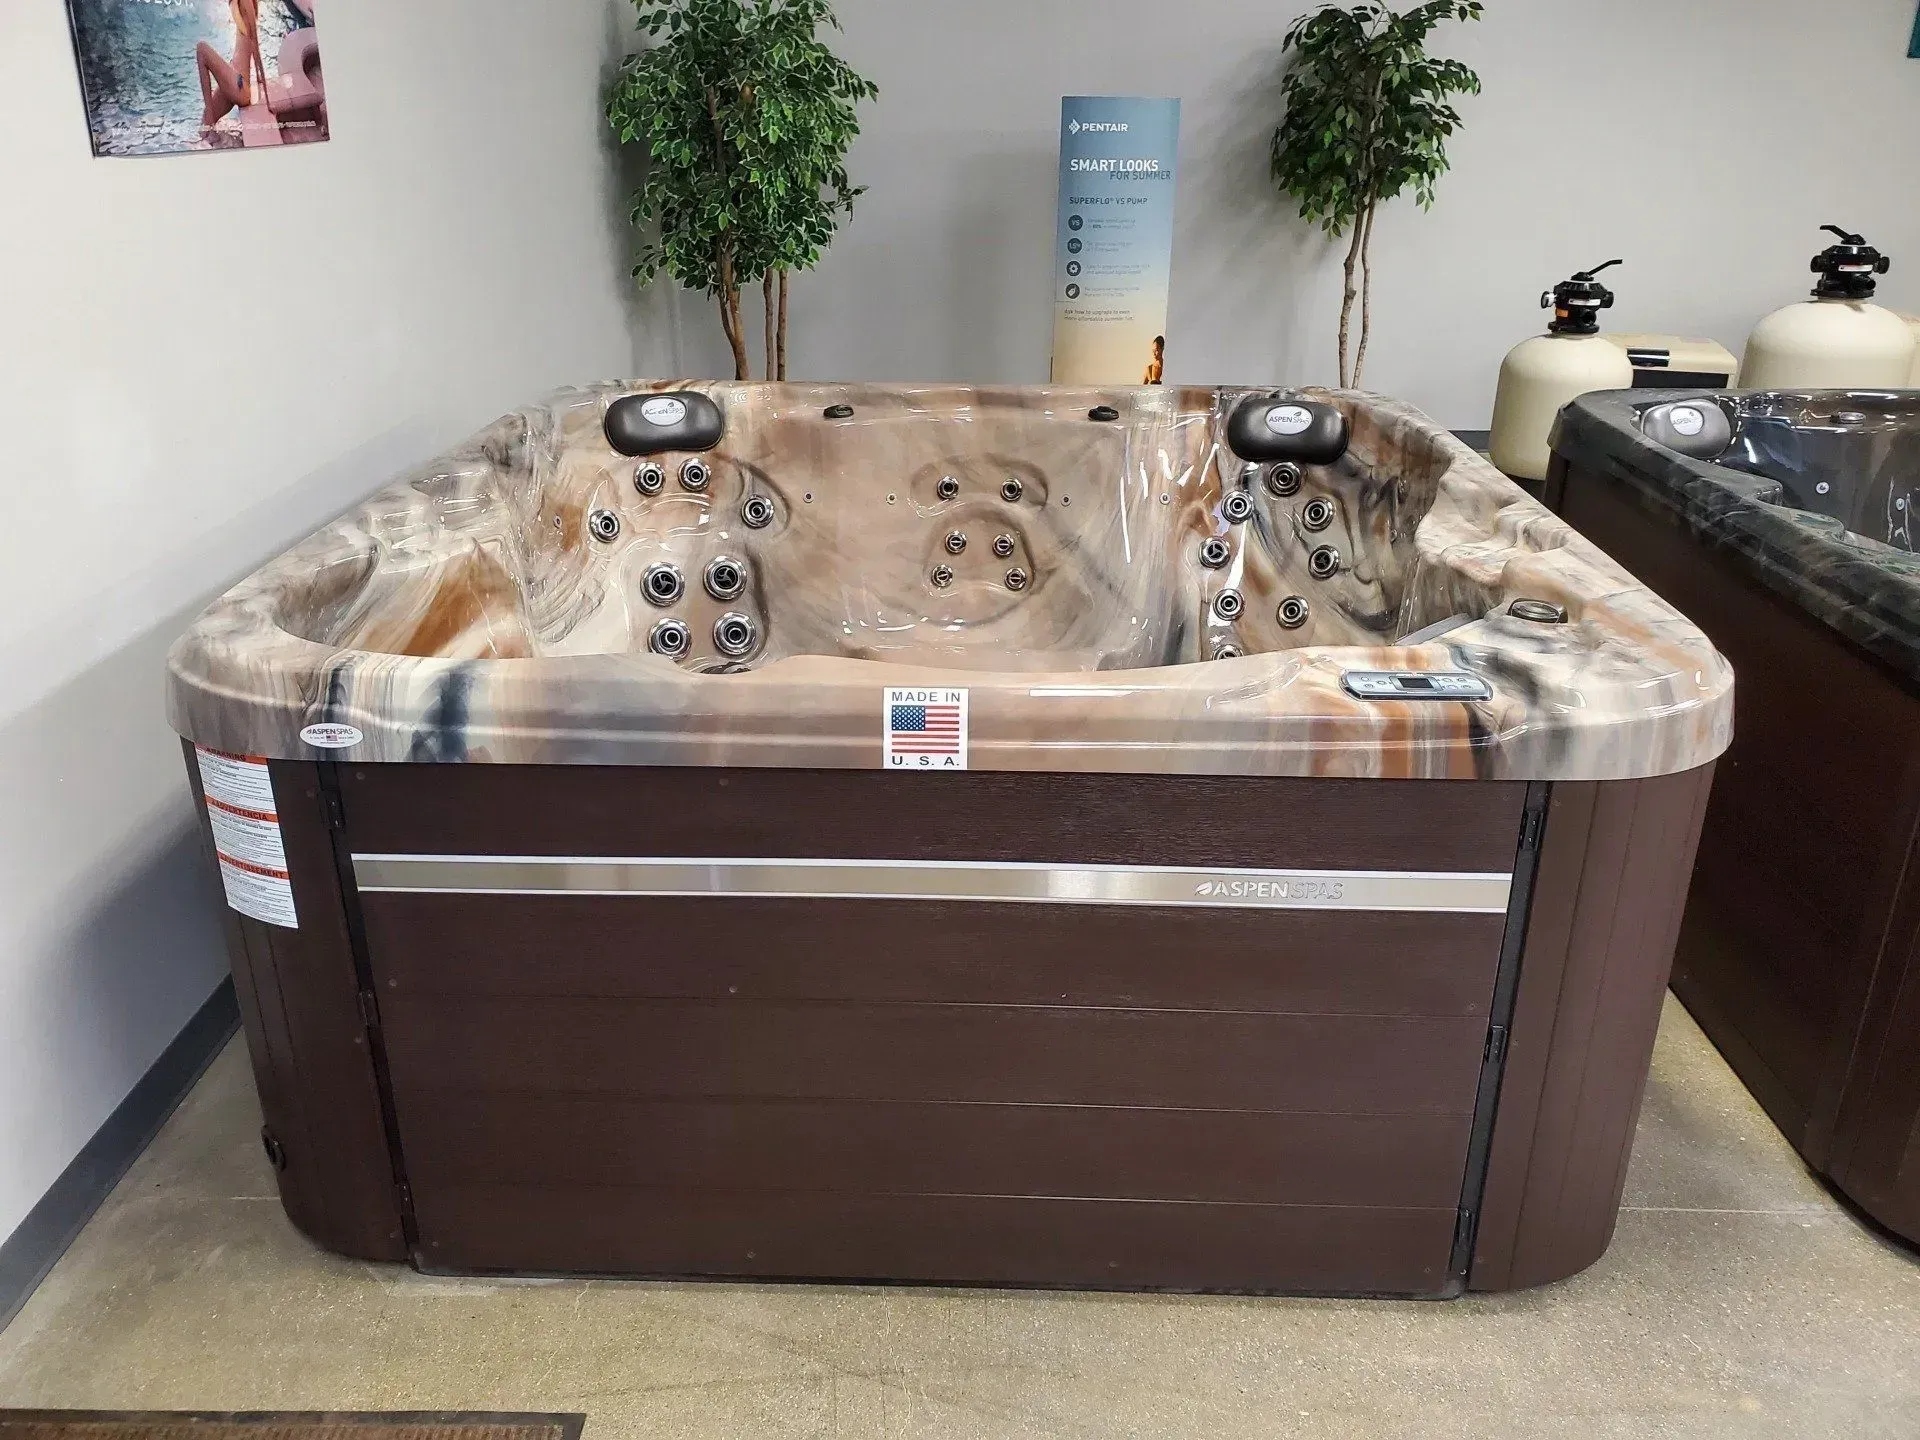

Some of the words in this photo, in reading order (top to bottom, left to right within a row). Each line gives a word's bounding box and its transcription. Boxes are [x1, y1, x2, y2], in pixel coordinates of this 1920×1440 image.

[1082, 123, 1128, 132] PENTAIR
[1070, 159, 1116, 171] SMART
[1119, 160, 1159, 171] LOOKS
[1110, 171, 1130, 180] FOR
[1132, 171, 1171, 180] SUMMER
[891, 691, 938, 702] MADE
[945, 692, 960, 702] IN
